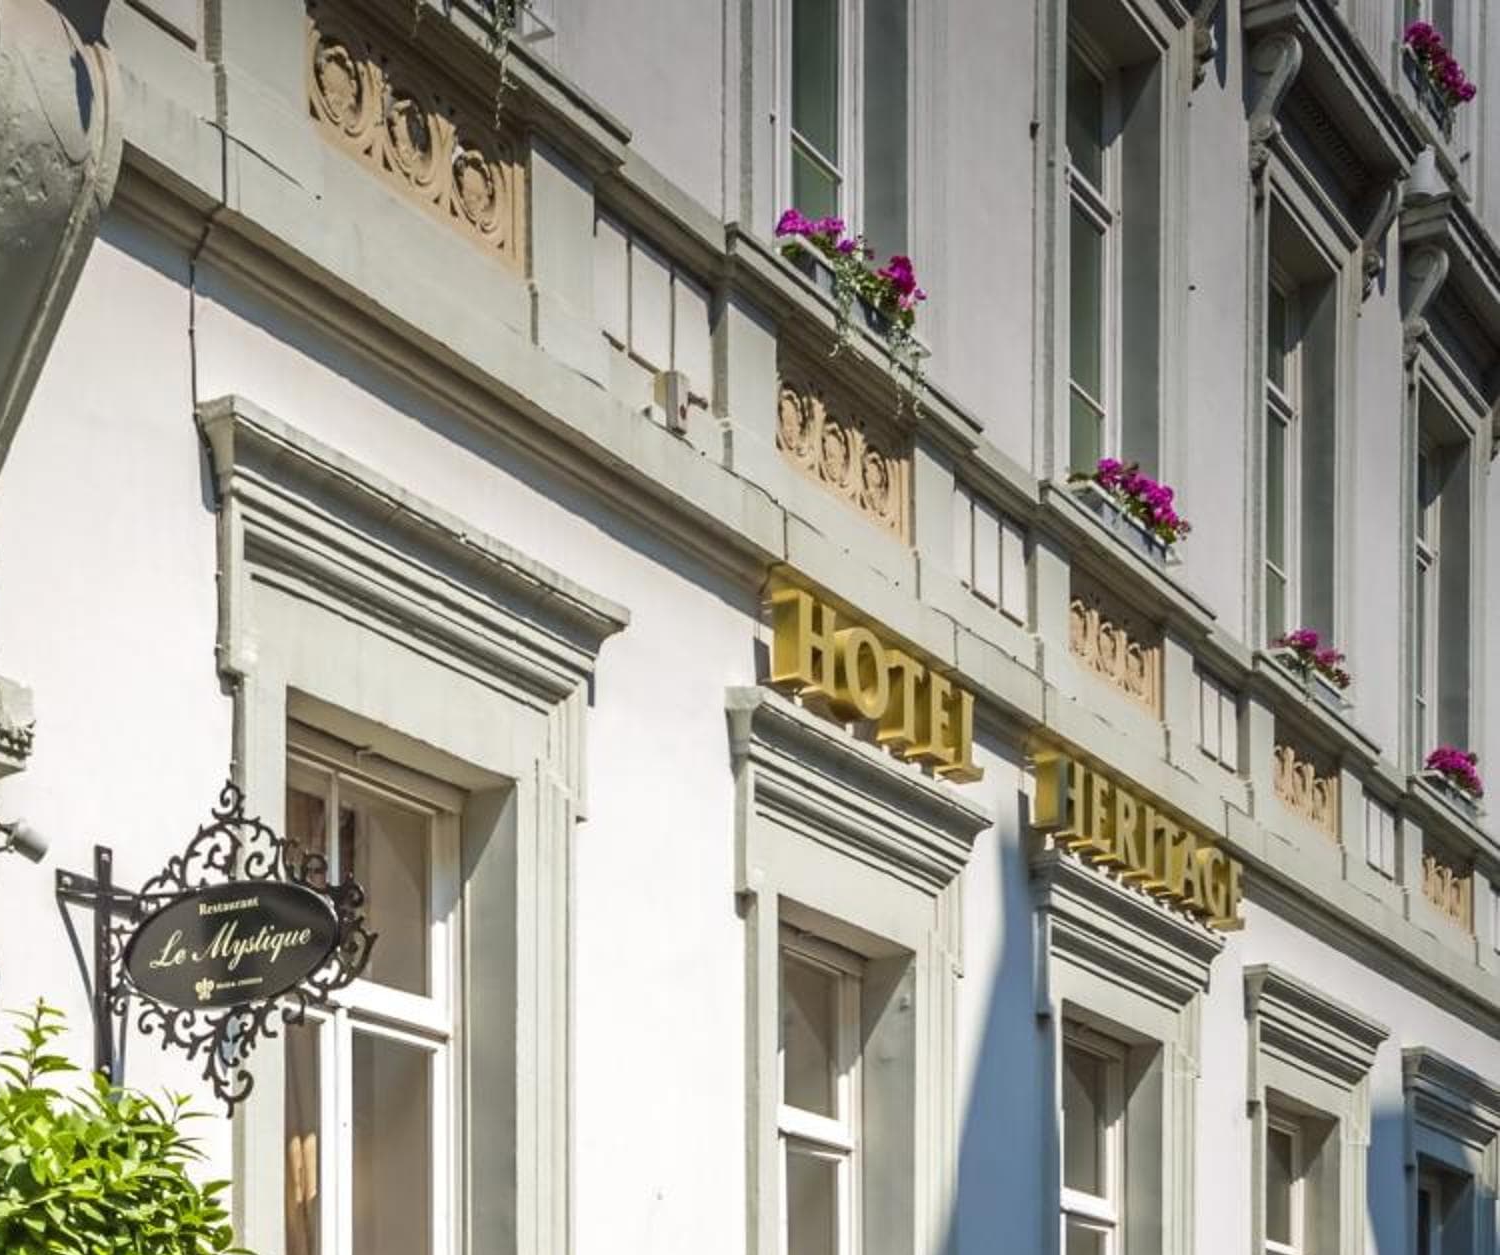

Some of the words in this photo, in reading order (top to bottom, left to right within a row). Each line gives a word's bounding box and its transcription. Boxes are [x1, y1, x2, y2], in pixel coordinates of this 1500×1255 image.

[770, 588, 985, 785] HOTEL
[1031, 752, 1245, 933] HERITAGE
[198, 896, 260, 916] Restaurant
[192, 919, 312, 971] Mystique
